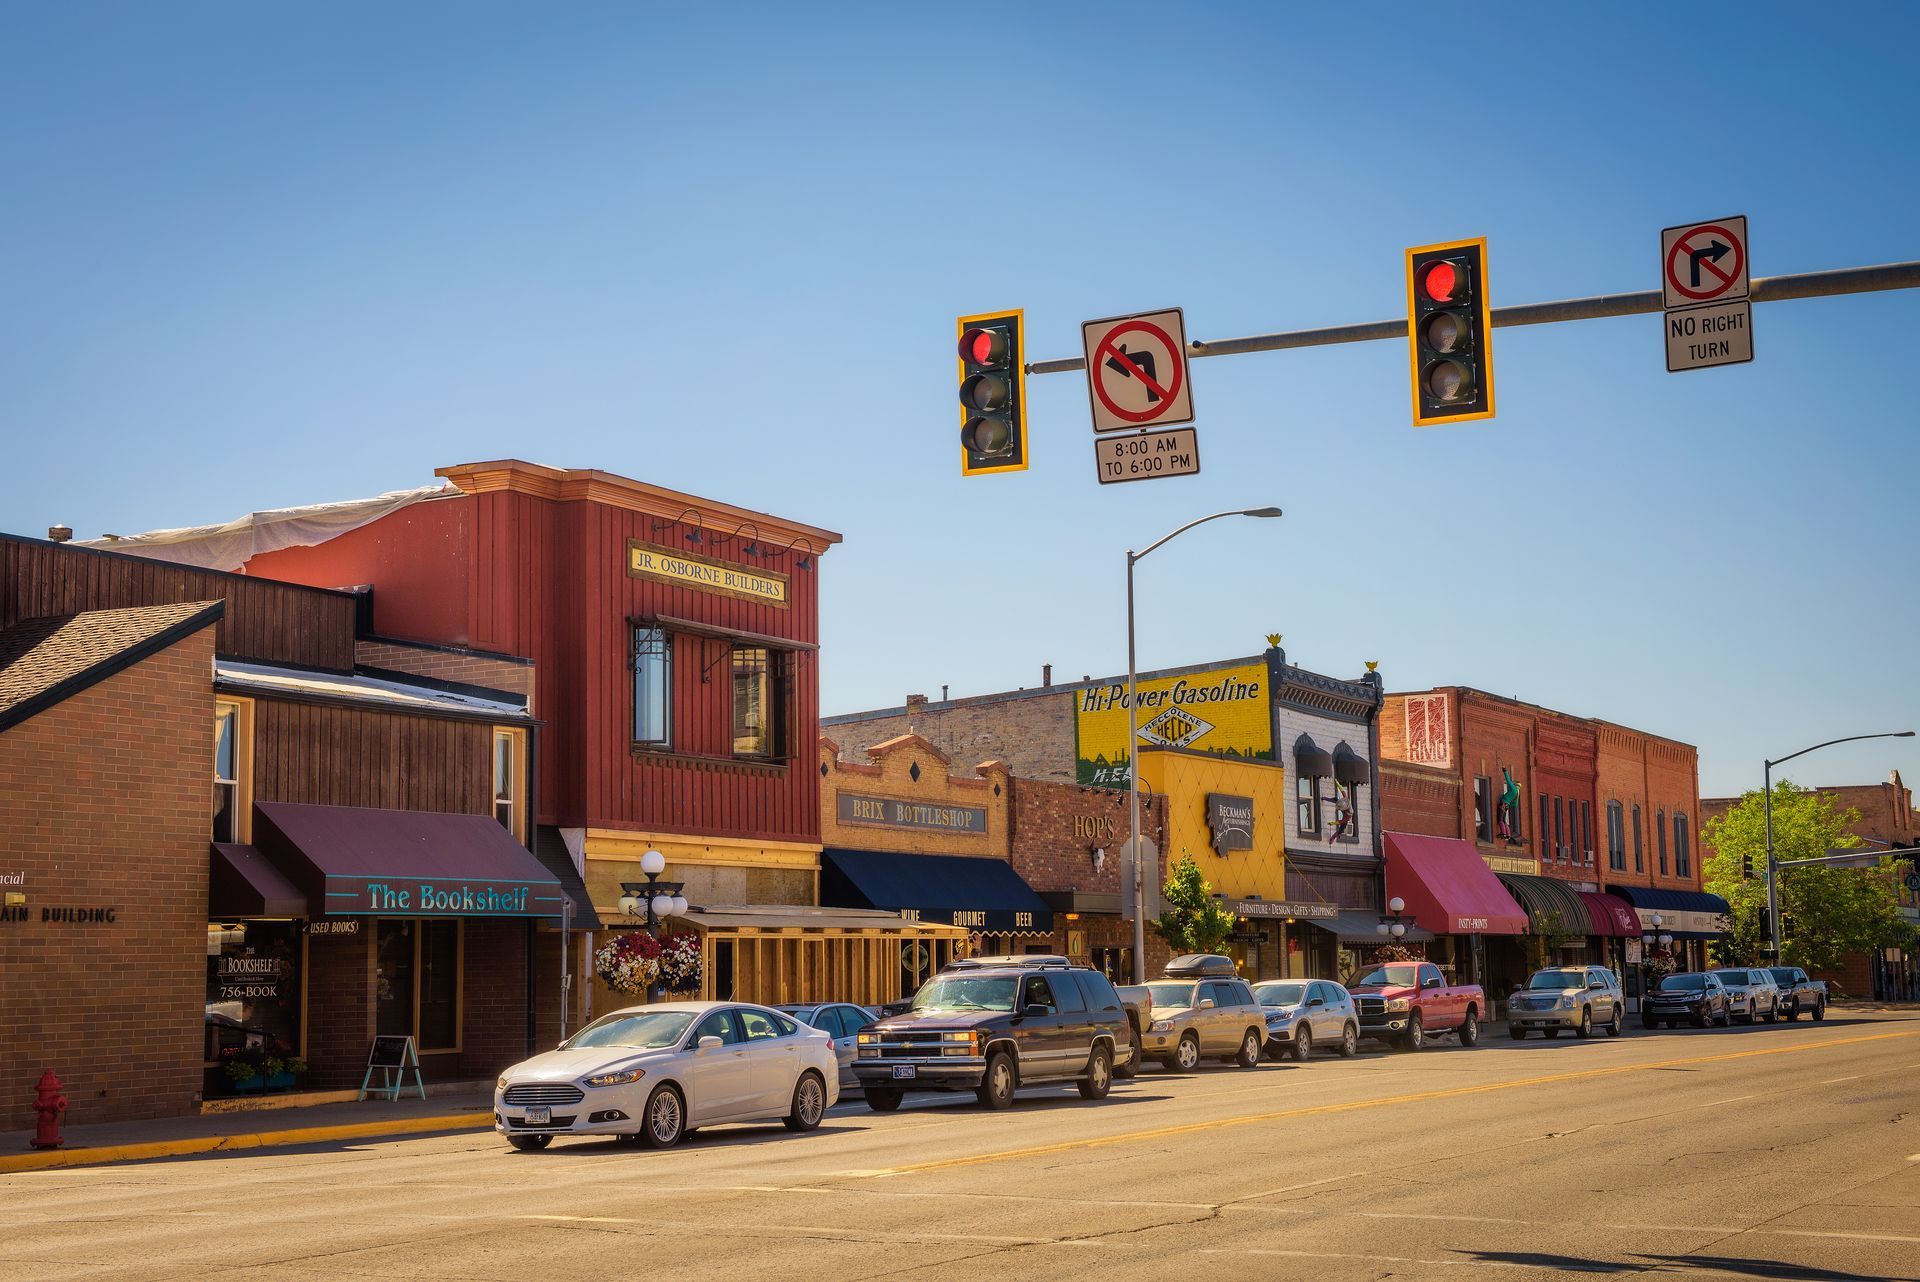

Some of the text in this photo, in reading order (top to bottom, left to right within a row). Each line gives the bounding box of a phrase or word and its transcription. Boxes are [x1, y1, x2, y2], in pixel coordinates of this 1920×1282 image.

[1671, 313, 1745, 338] NO RIGHT
[1688, 340, 1730, 361] TURN
[1115, 437, 1177, 457] 8:00 AM
[1105, 453, 1191, 476] TO 6:00 PM
[637, 553, 780, 596] JR. OSBORNE BUILDERS
[1173, 677, 1259, 704] Gasoline
[1144, 708, 1201, 732] HECCOLENE
[1157, 716, 1192, 742] HECCO
[853, 800, 972, 828] BRIX BOTTLESHOP
[1219, 804, 1251, 819] BECKMAN'S
[1072, 815, 1114, 840] HOP'S
[367, 883, 529, 911] The Bookshelf
[42, 907, 116, 923] BUILDING
[900, 909, 1033, 927] WINE GOURMET BEER
[1239, 902, 1334, 917] FURNITURE DESIGN GIFTS SHIPPING
[310, 921, 356, 934] USED BOOKS
[1458, 918, 1488, 929] INSTY-PRINTS
[228, 957, 273, 973] BOOKSHELF
[220, 986, 277, 998] 756-BOOK
